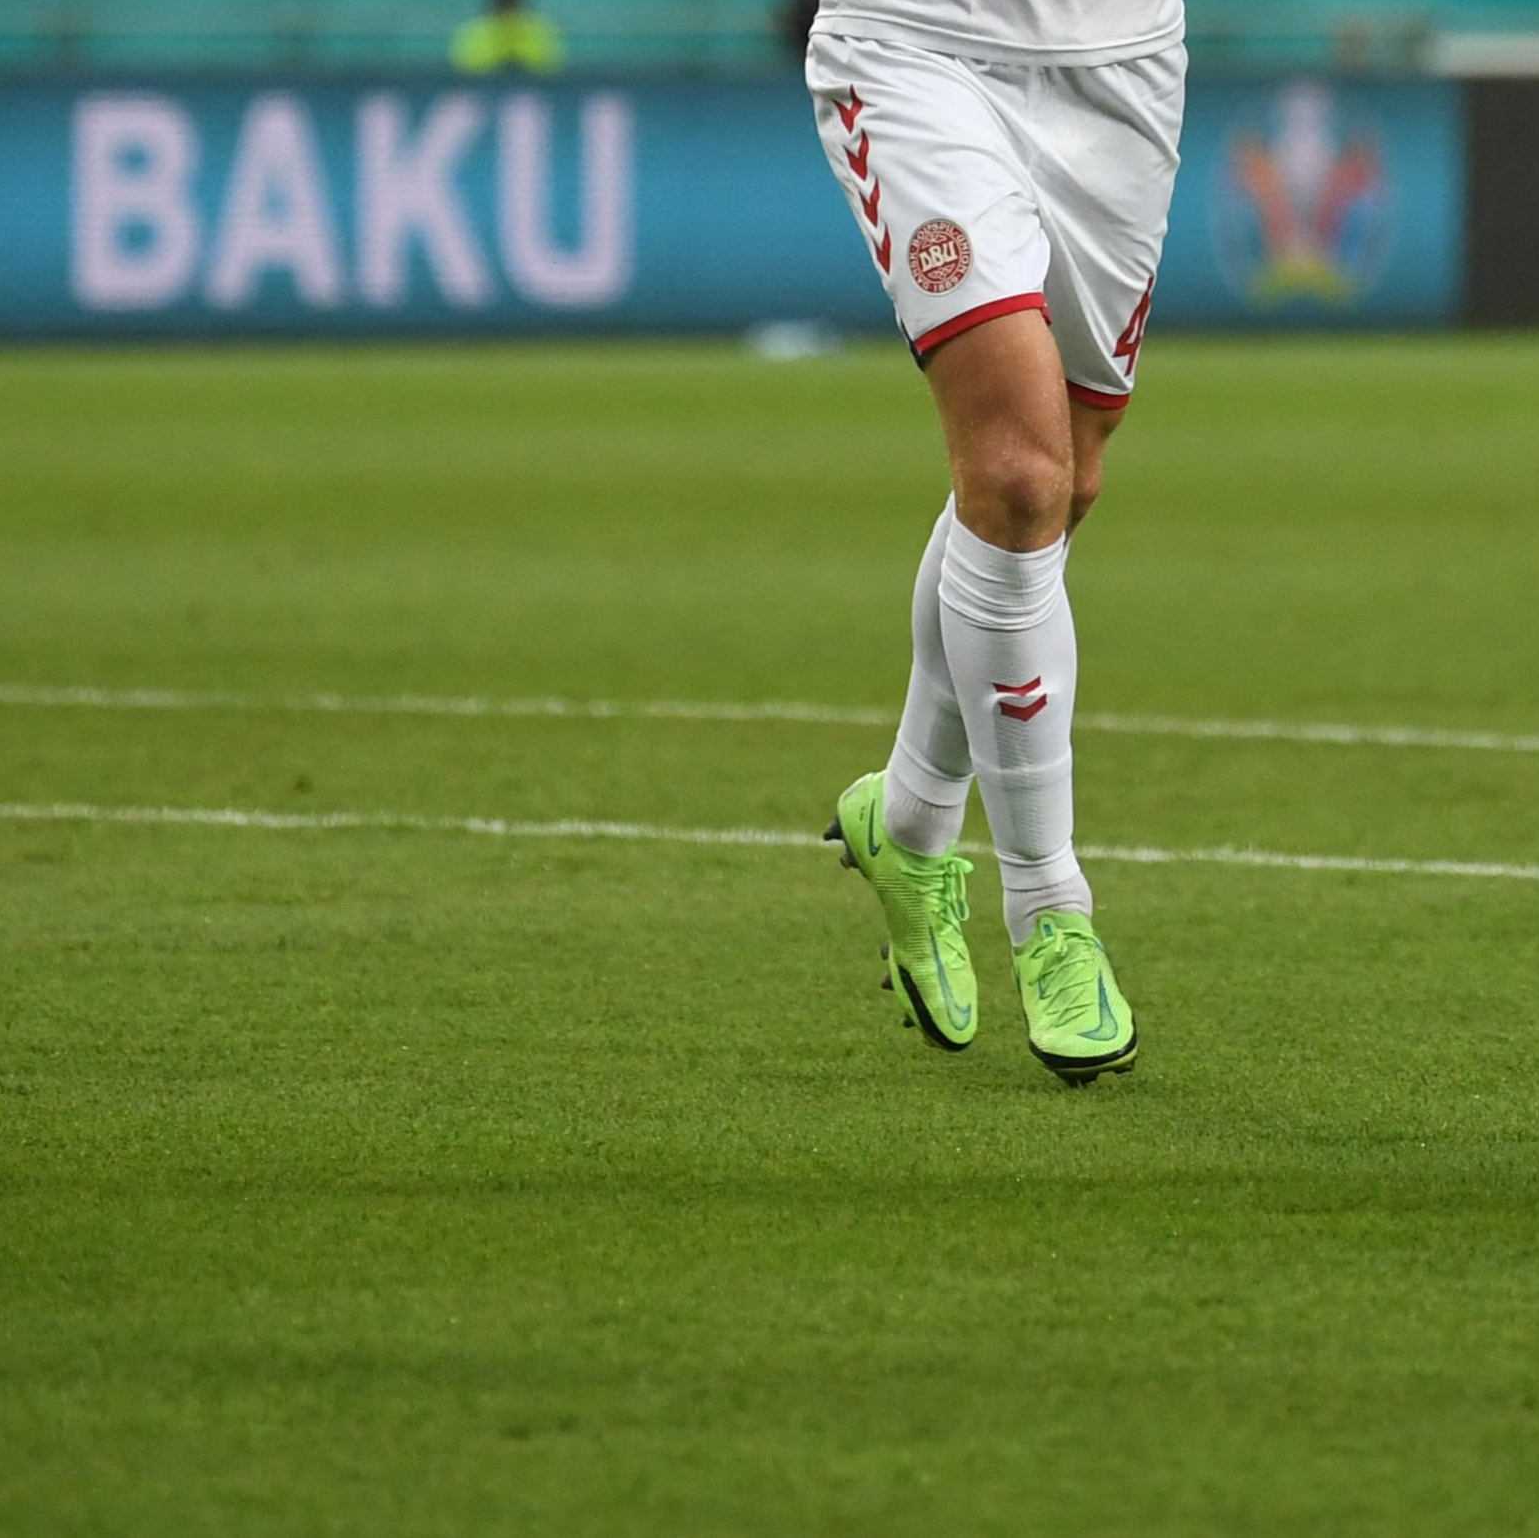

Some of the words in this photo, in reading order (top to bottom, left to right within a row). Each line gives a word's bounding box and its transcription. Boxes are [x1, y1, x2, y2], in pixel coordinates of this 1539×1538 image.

[71, 89, 639, 312] BAKU
[919, 241, 958, 272] DBU
[1112, 276, 1154, 377] 4
